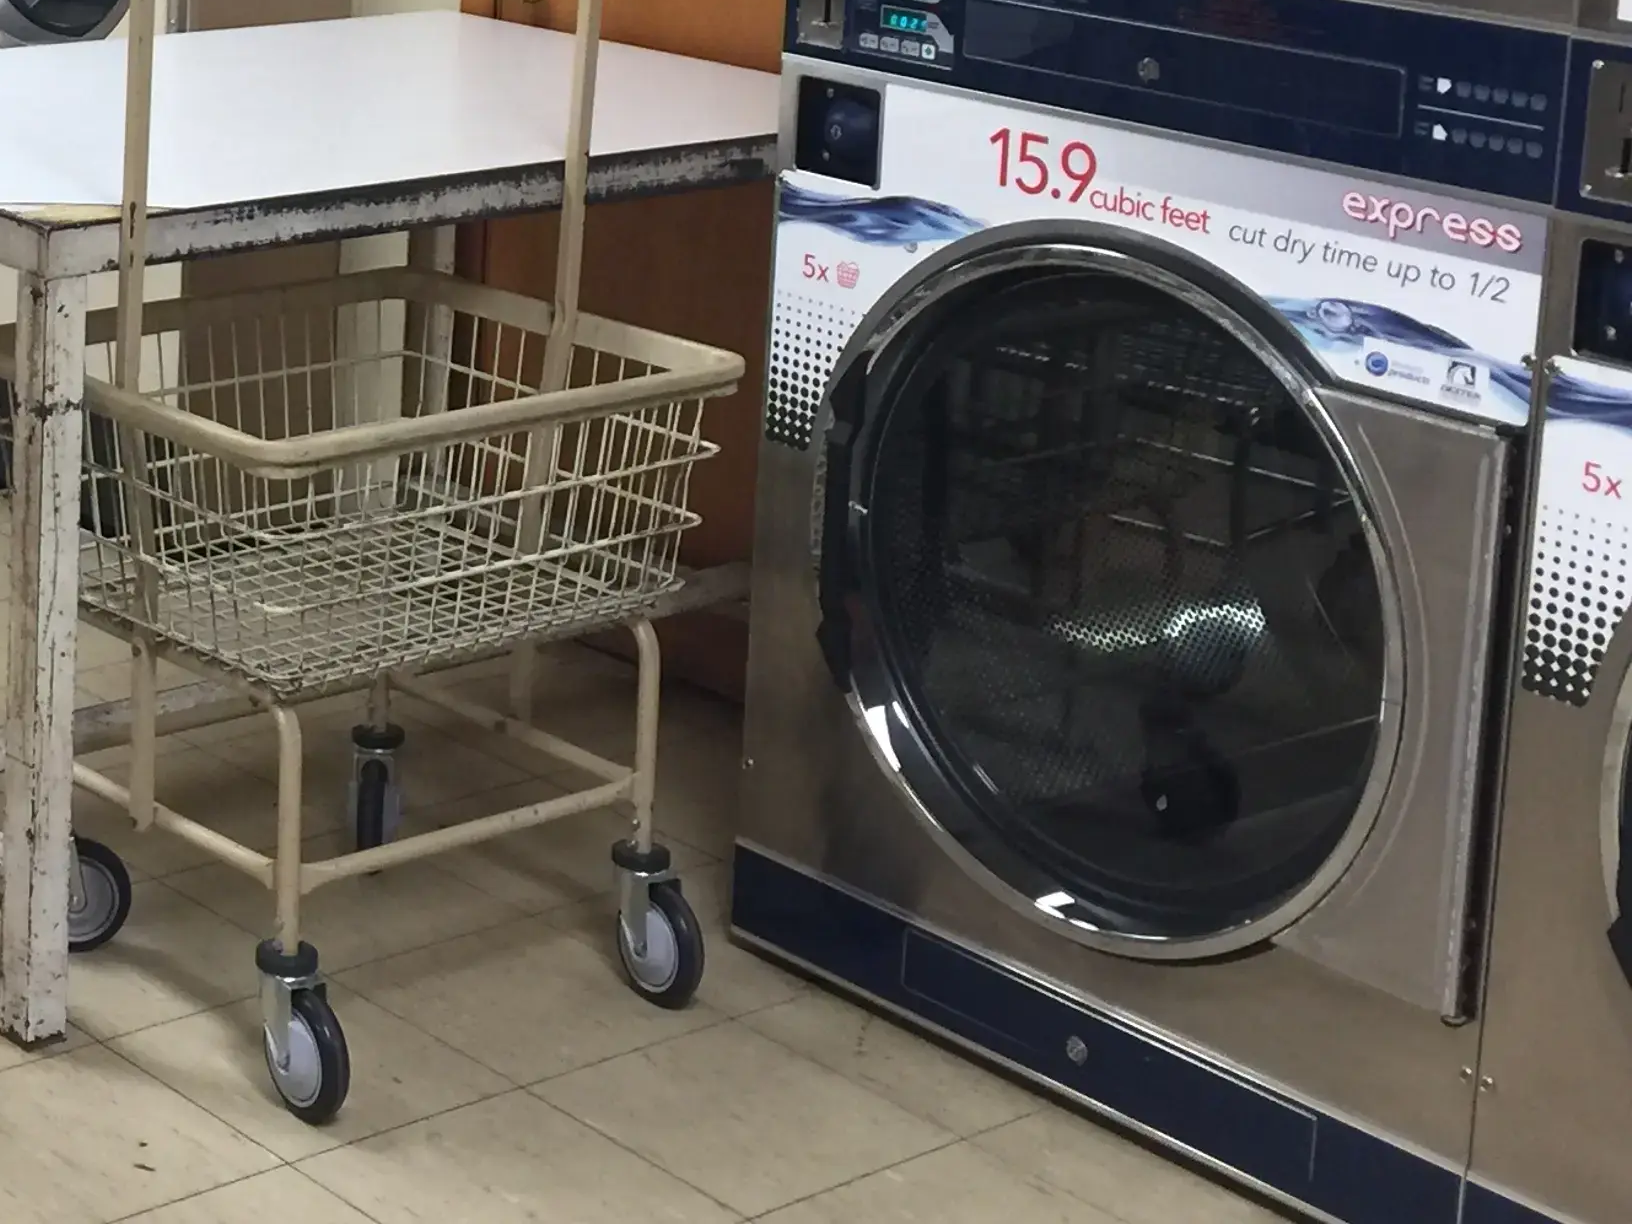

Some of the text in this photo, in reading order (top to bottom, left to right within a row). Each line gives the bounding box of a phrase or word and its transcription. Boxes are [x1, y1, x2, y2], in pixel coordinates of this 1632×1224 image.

[989, 127, 1212, 234] 15.9 cubic feet
[1342, 190, 1524, 253] express
[802, 253, 830, 283] 5x
[1228, 224, 1512, 304] cut dry time up to 1/2
[1582, 461, 1622, 500] 5x
